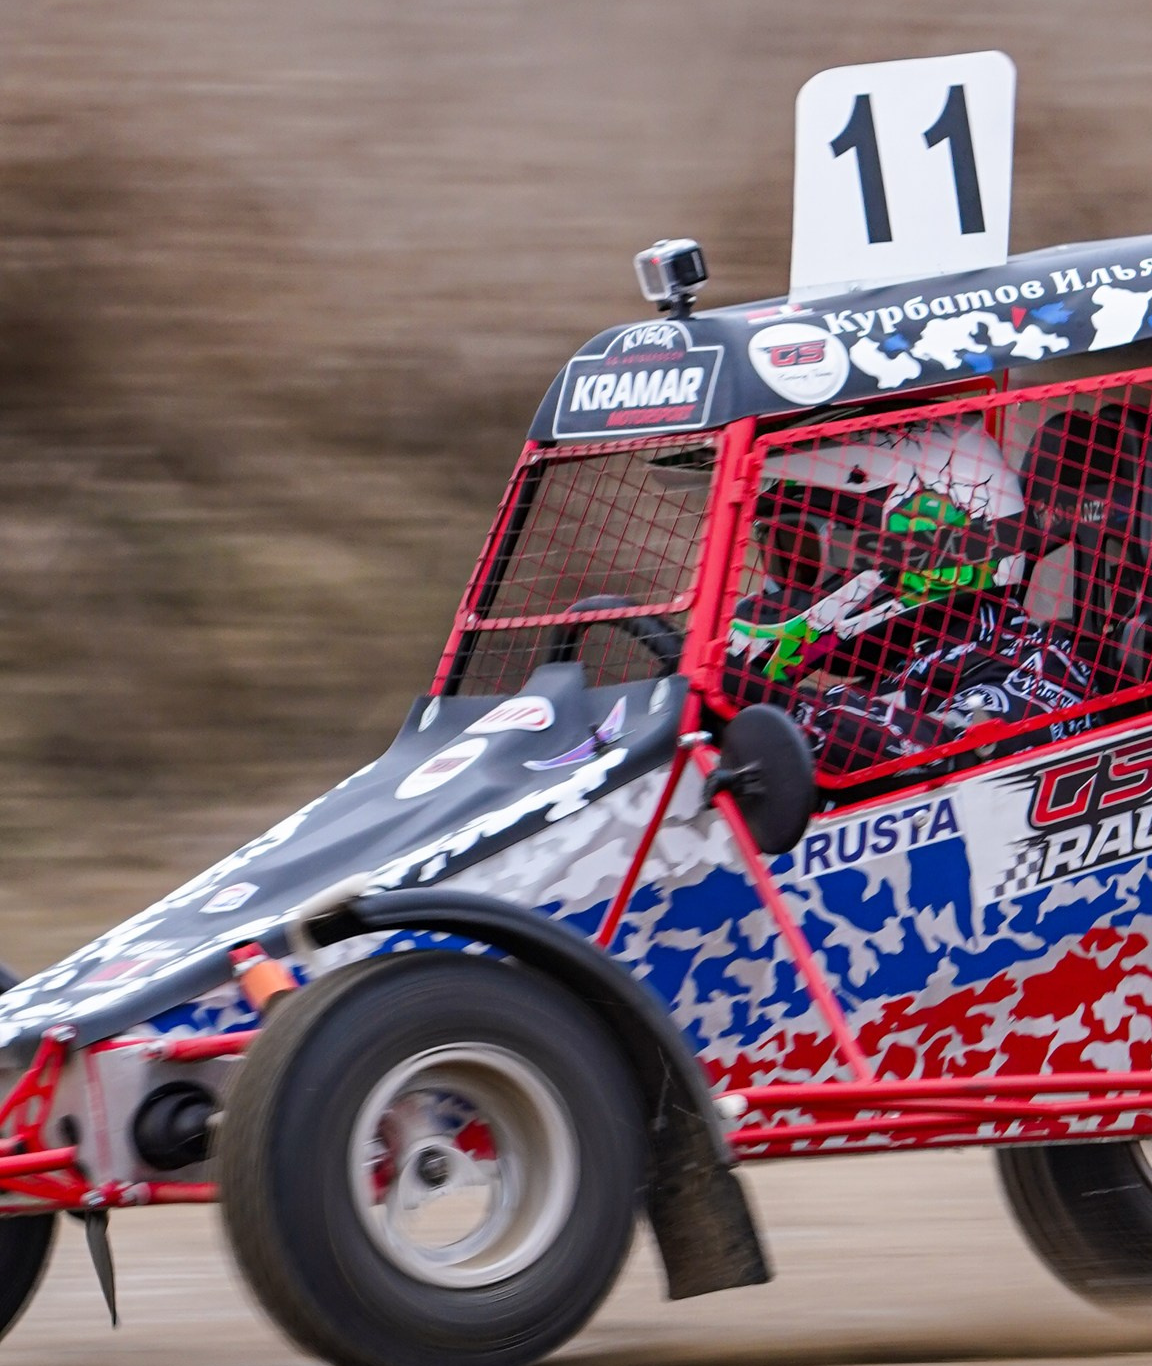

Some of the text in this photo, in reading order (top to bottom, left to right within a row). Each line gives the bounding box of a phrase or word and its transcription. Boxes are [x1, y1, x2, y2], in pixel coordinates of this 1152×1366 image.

[829, 84, 986, 244] 11
[822, 280, 1044, 337] Курбатов
[770, 339, 826, 367] GS
[570, 367, 704, 412] KRAMAR
[803, 797, 960, 875] RUSTA
